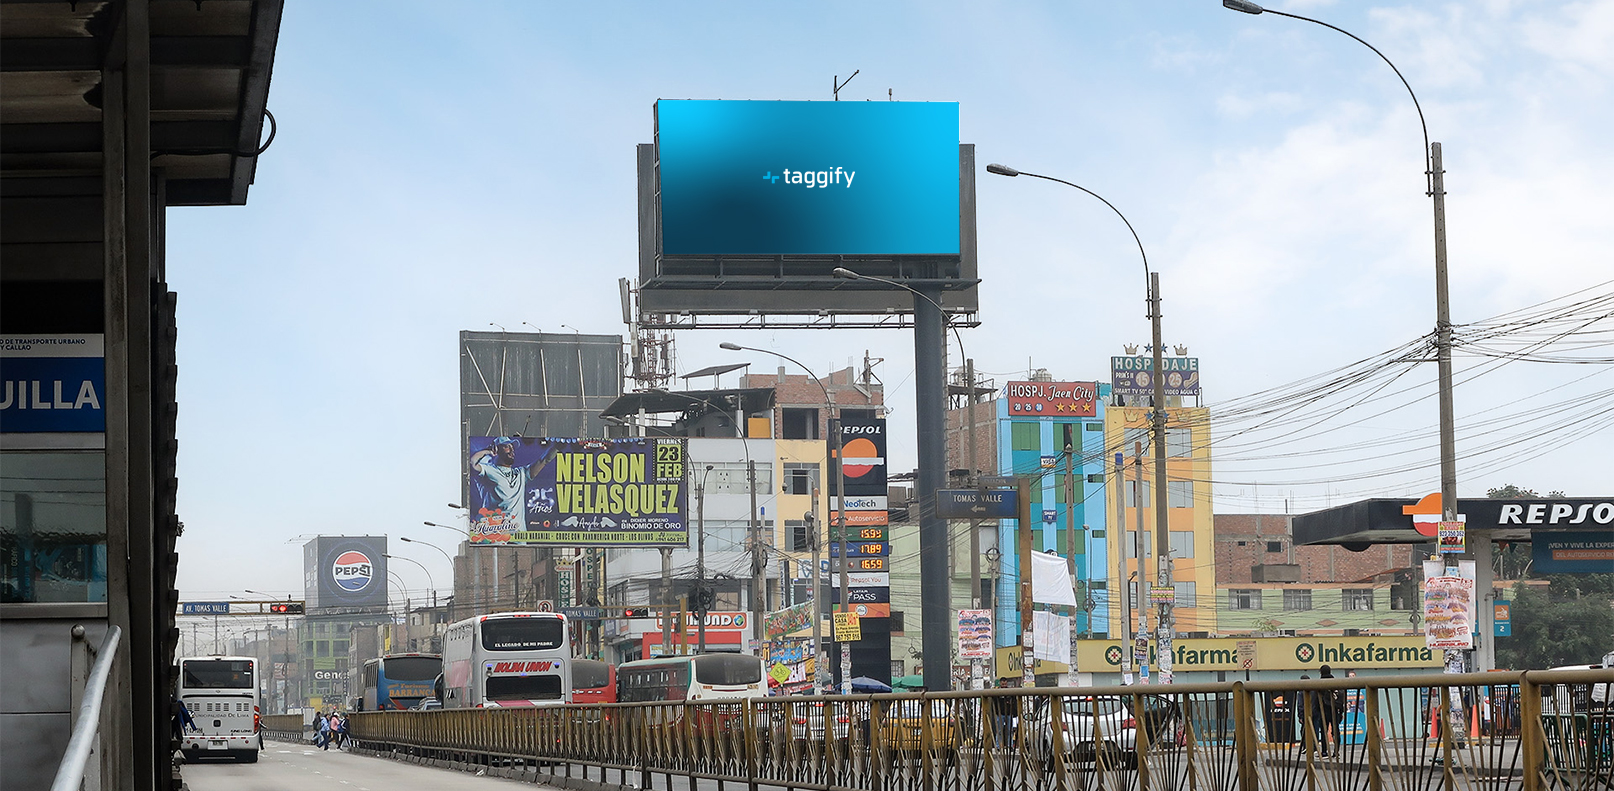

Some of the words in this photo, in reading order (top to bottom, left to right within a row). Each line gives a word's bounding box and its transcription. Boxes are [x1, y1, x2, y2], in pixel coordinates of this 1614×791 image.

[783, 166, 855, 188] taggify
[1115, 358, 1197, 370] HOSPDAJE
[1048, 385, 1072, 401] Jaen
[1073, 386, 1094, 402] City
[840, 426, 881, 434] EPSOL
[659, 446, 679, 461] 23
[556, 452, 645, 482] NELSON
[657, 464, 682, 478] FEB
[528, 488, 555, 506] 25
[556, 484, 679, 517] VELASQUEZ
[953, 494, 976, 502] TOMAS
[981, 494, 1002, 502] VALLE
[1499, 503, 1614, 524] REPSO
[335, 565, 371, 576] PEPSI
[1318, 643, 1432, 662] Inkafarma
[494, 662, 525, 673] MOLINA
[525, 662, 552, 672] UNION
